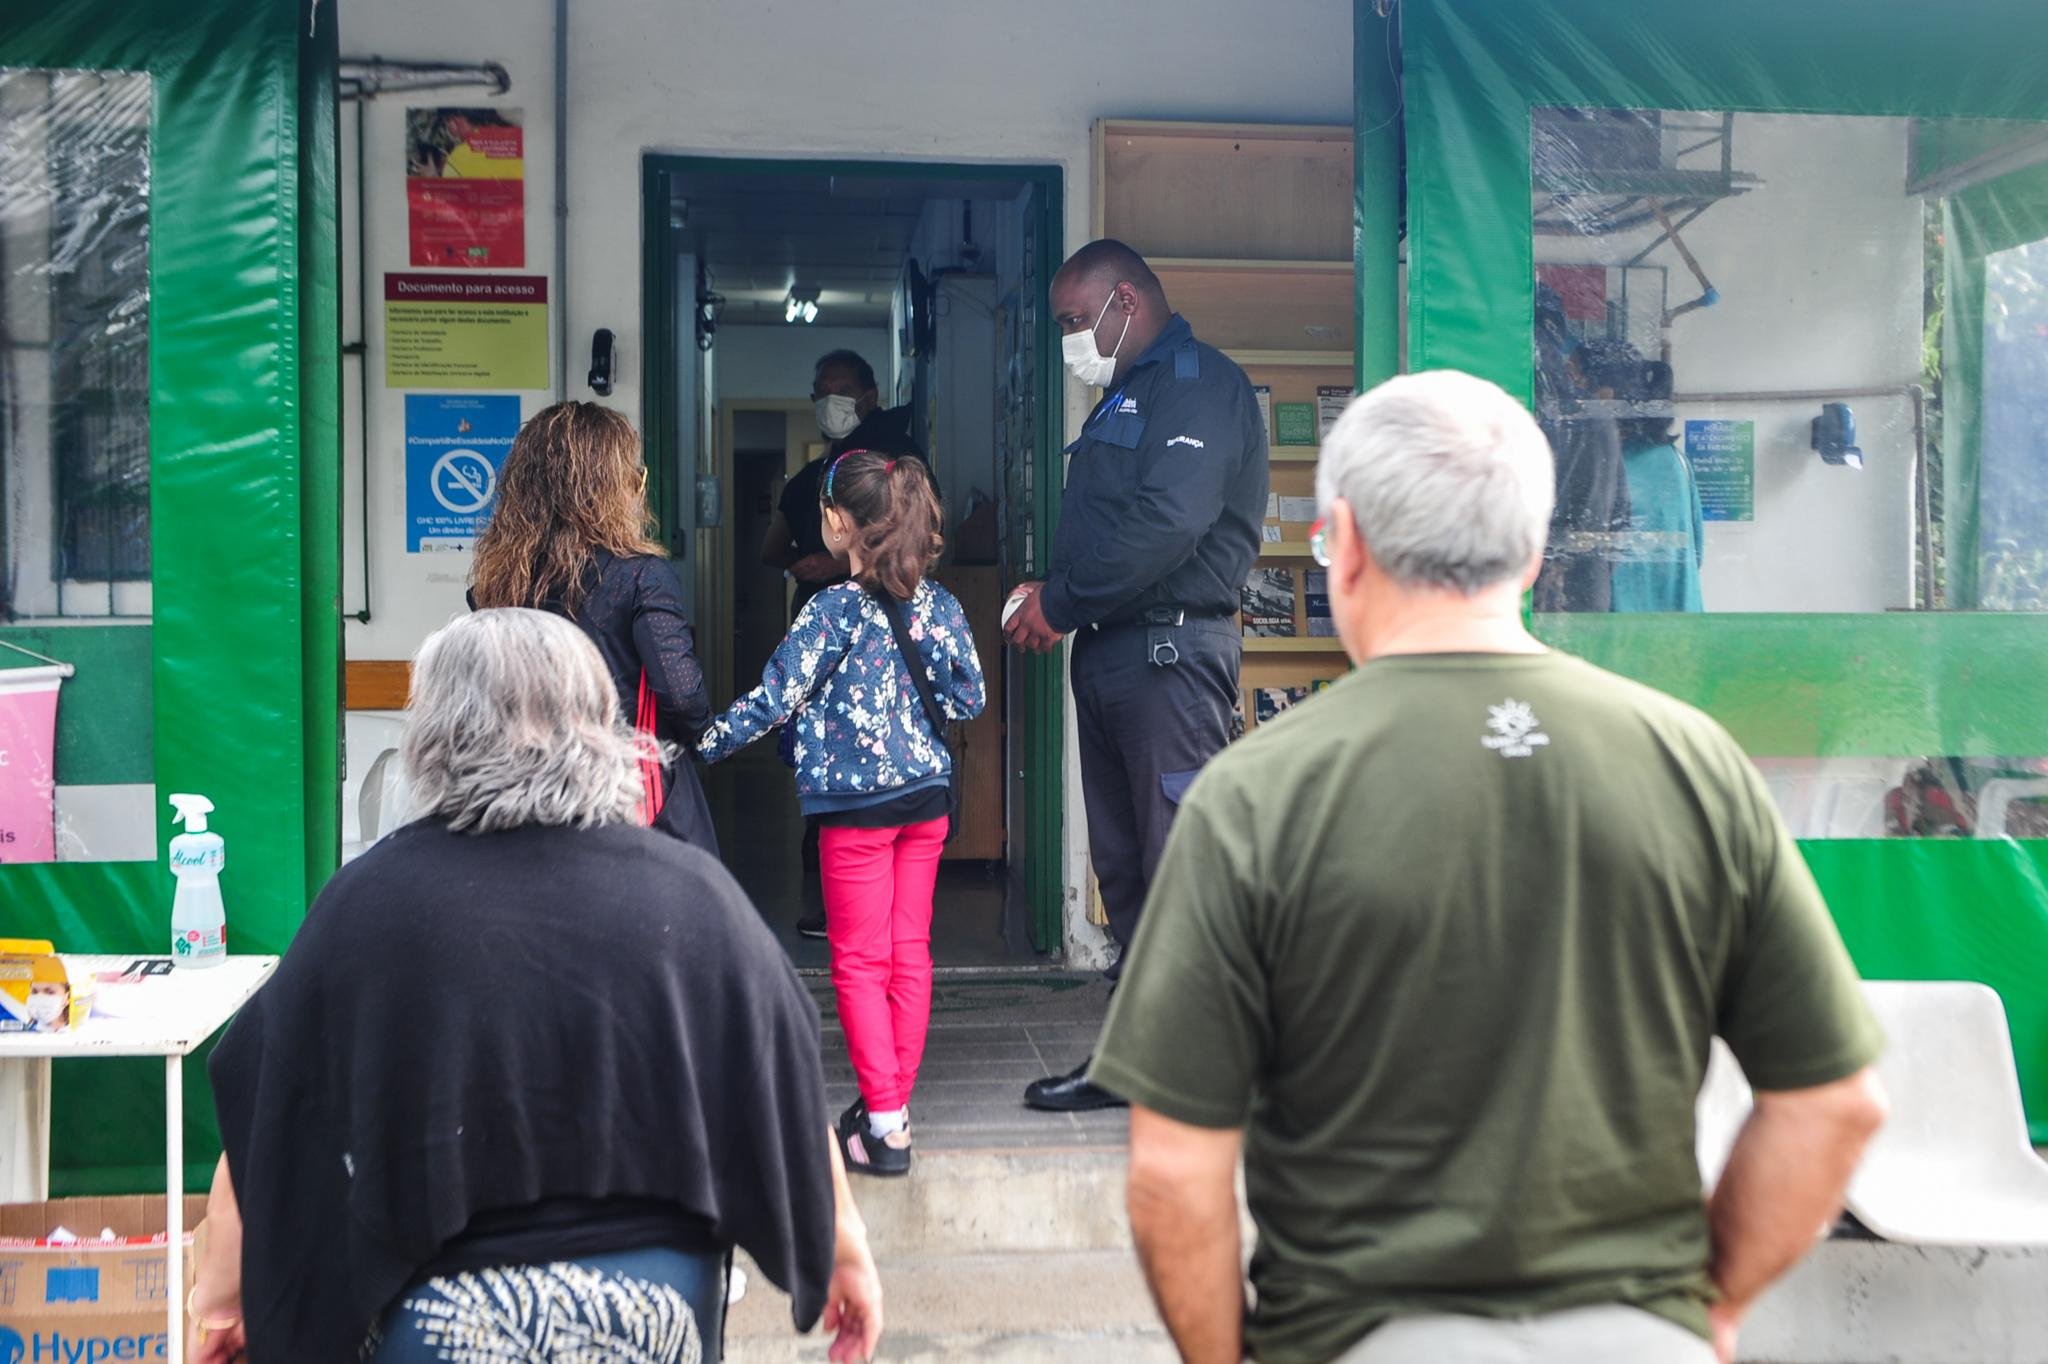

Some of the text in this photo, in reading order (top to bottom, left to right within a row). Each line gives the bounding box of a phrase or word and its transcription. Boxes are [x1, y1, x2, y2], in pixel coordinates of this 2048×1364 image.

[398, 281, 535, 296] Documento para acesso
